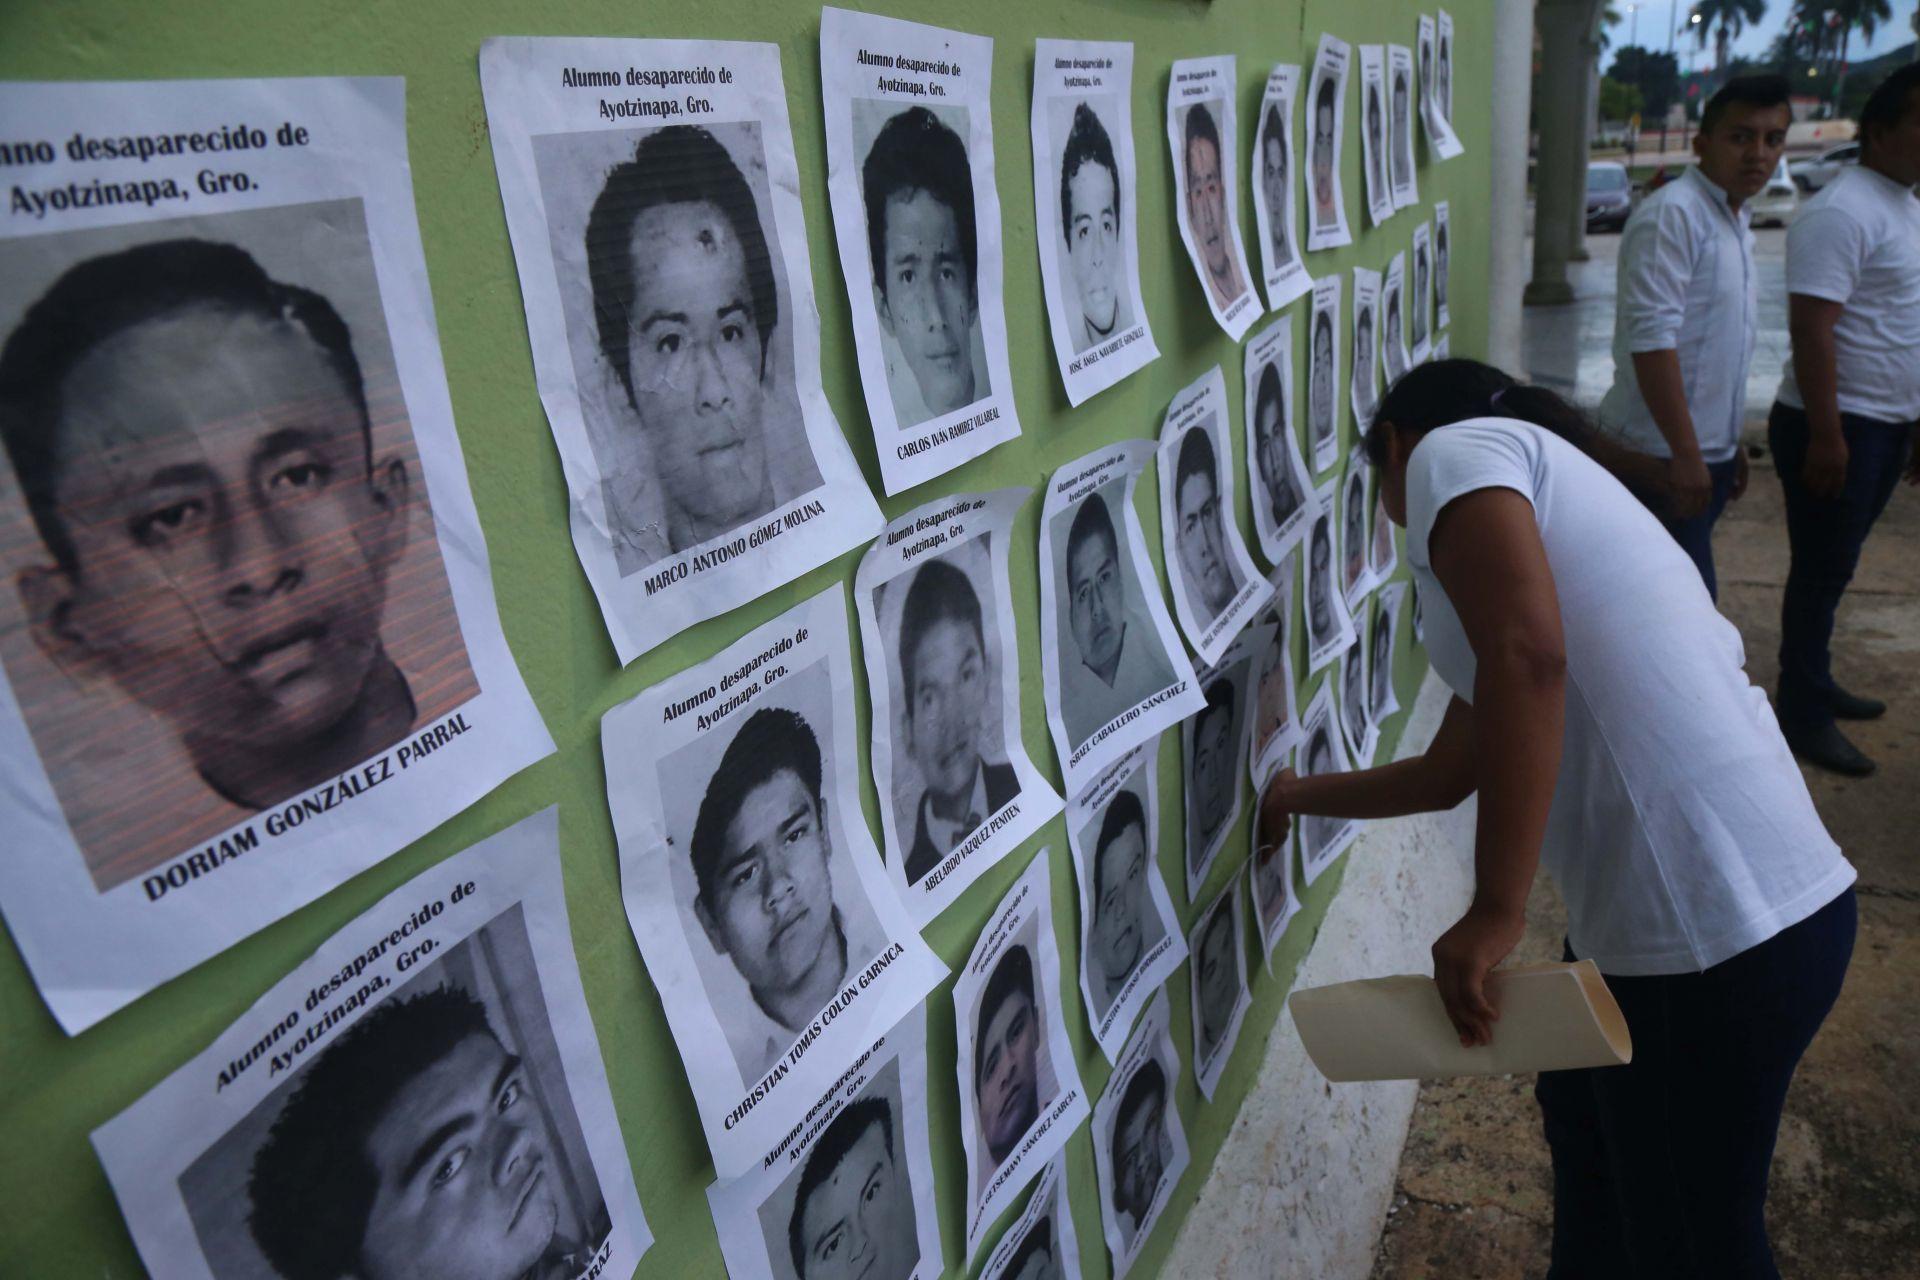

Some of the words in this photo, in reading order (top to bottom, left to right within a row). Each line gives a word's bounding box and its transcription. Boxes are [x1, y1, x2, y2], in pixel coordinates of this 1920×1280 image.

[562, 68, 621, 88] Alumno
[626, 67, 716, 88] desaparecido
[719, 67, 733, 84] de
[857, 49, 894, 68] Alumno
[896, 55, 949, 75] desaparecido
[952, 63, 961, 76] de
[878, 76, 927, 96] Ayotzinapa,
[929, 81, 946, 96] Gro.
[600, 98, 683, 121] Ayotzinapa,
[687, 96, 714, 113] Gro.
[67, 125, 267, 163] desaparecido
[276, 122, 310, 147] de
[11, 177, 190, 218] Ayotzinapa,
[197, 169, 260, 194] Gro.
[897, 436, 931, 460] CARLOS
[931, 427, 949, 447] IVÁN
[644, 562, 688, 597] MARCO
[693, 538, 746, 574] ANTONIO
[749, 518, 783, 548] GÓMEZ
[783, 500, 825, 530] MOLINA
[886, 524, 914, 547] Alumno
[916, 502, 970, 532] desaparecido
[973, 499, 986, 510] de
[902, 532, 948, 561] Ayotzinapa,
[950, 523, 965, 538] Gro.
[663, 685, 717, 723] Alumno
[720, 637, 793, 692] desaparecido
[795, 627, 809, 644] de
[697, 682, 761, 731] Ayotzinapa,
[764, 665, 789, 685] Gro.
[1069, 742, 1091, 769] ISRAEL
[1092, 708, 1140, 746] CABALLERO
[142, 826, 260, 901] DORIAM
[265, 757, 394, 836] GONZÁLEZ
[396, 712, 472, 769] PARRAL
[925, 853, 961, 893] ABELARDO
[961, 826, 991, 859] VÁZQUEZ
[989, 803, 1021, 834] PENITEN
[217, 1010, 299, 1094] Alumno
[304, 900, 444, 1012] desaparecido
[450, 881, 476, 904] de
[269, 975, 391, 1078] Ayotzinapa,
[396, 938, 440, 973] Gro.
[723, 1060, 789, 1131] CHRISTIAN
[787, 1019, 822, 1065] TOMÁS
[822, 984, 859, 1027] COLÓN
[858, 942, 905, 989] GARNICA
[764, 1122, 803, 1171] Alumno
[805, 1051, 871, 1124] desaparecido
[872, 1037, 885, 1053] de
[846, 1075, 867, 1097] Gro.
[985, 1154, 1022, 1205] GETSEMANY
[1052, 1090, 1077, 1120] GARCÍA
[581, 1241, 613, 1280] RAZ
